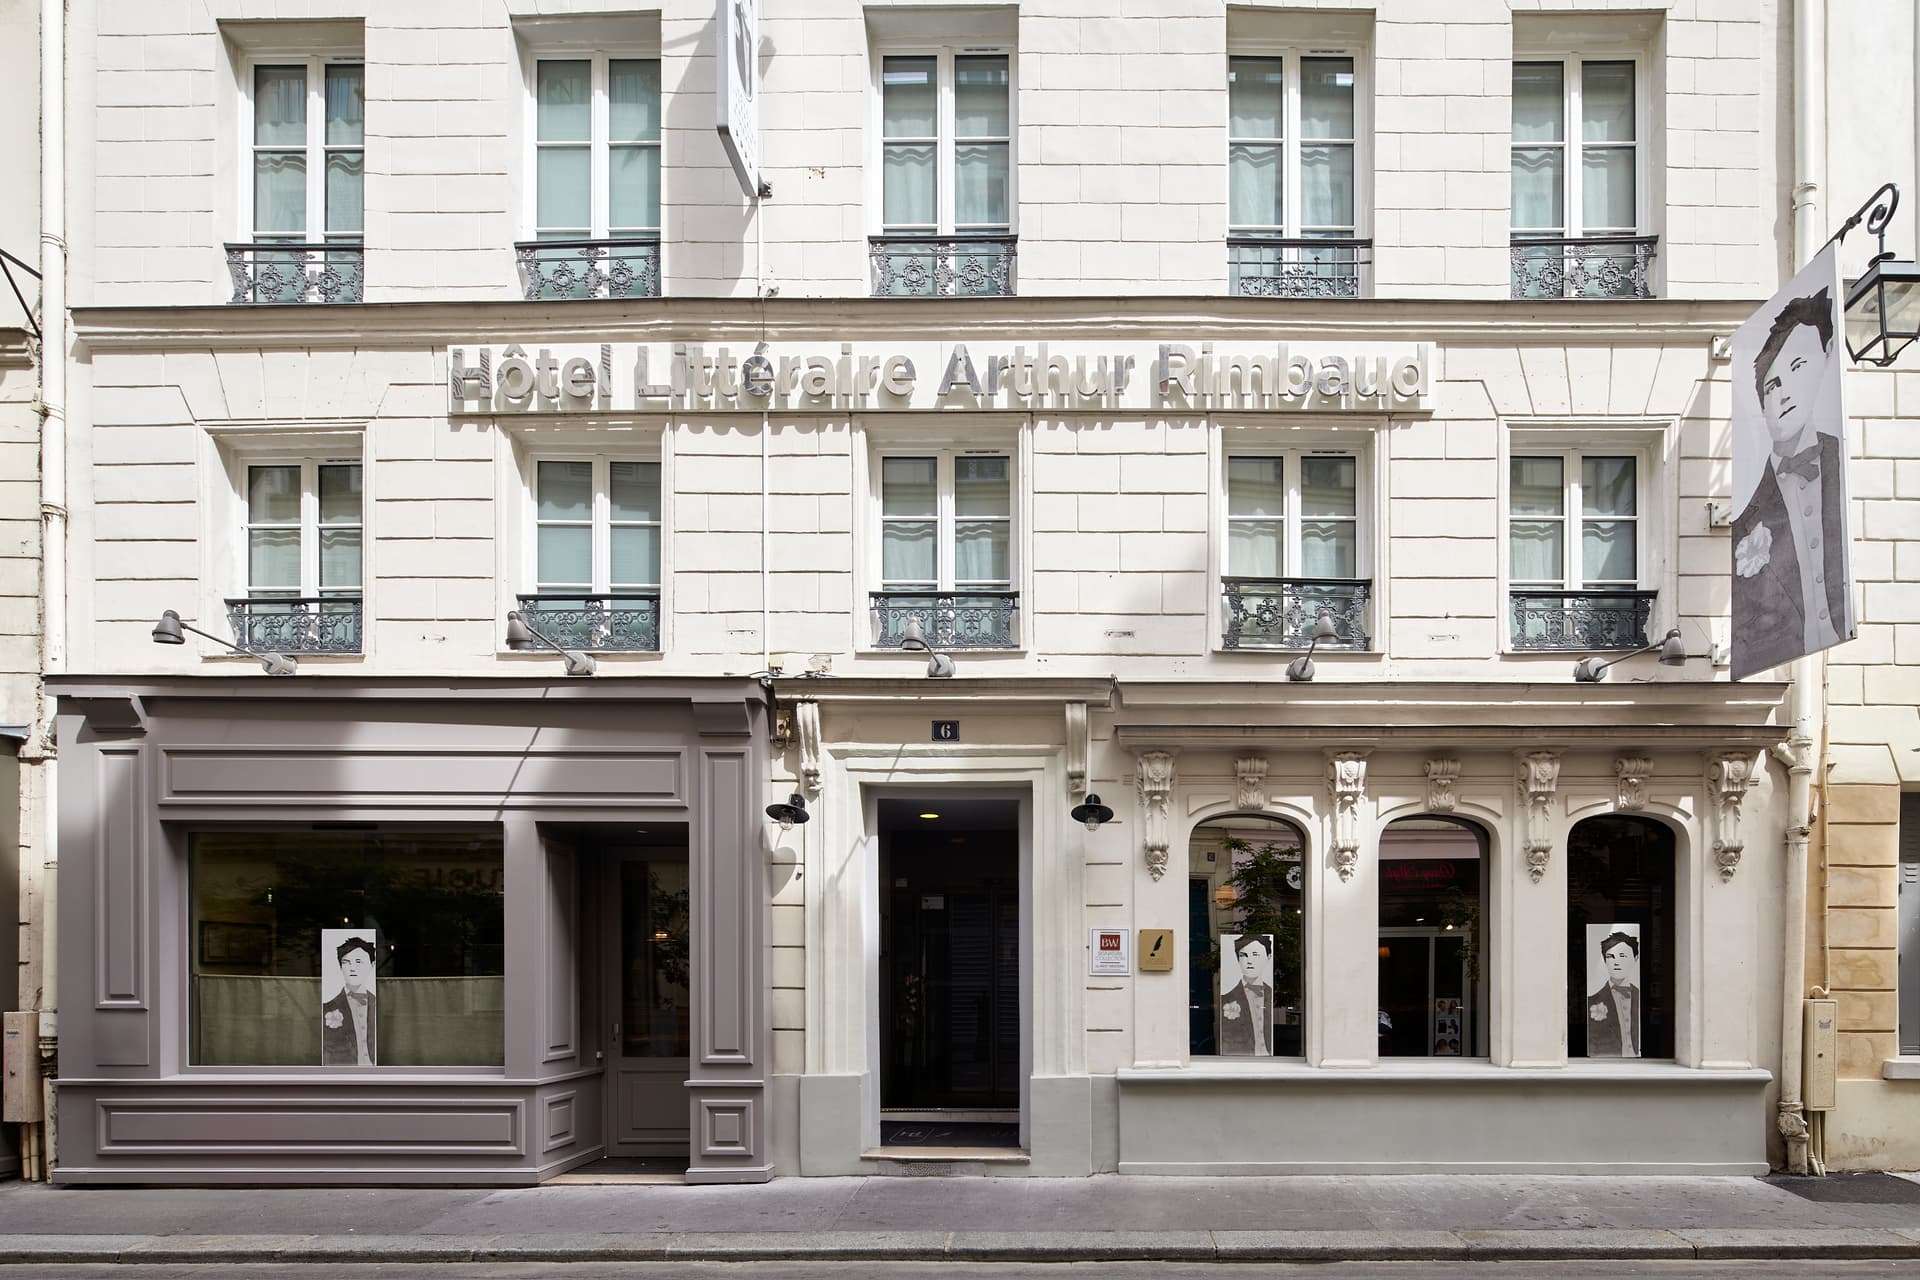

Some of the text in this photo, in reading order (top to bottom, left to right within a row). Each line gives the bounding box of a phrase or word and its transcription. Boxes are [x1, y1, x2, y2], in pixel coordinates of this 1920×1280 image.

[451, 341, 1429, 399] Hôtel Littéraire Arthur Rimbaud
[940, 723, 952, 739] 6
[1101, 937, 1120, 948] BW
